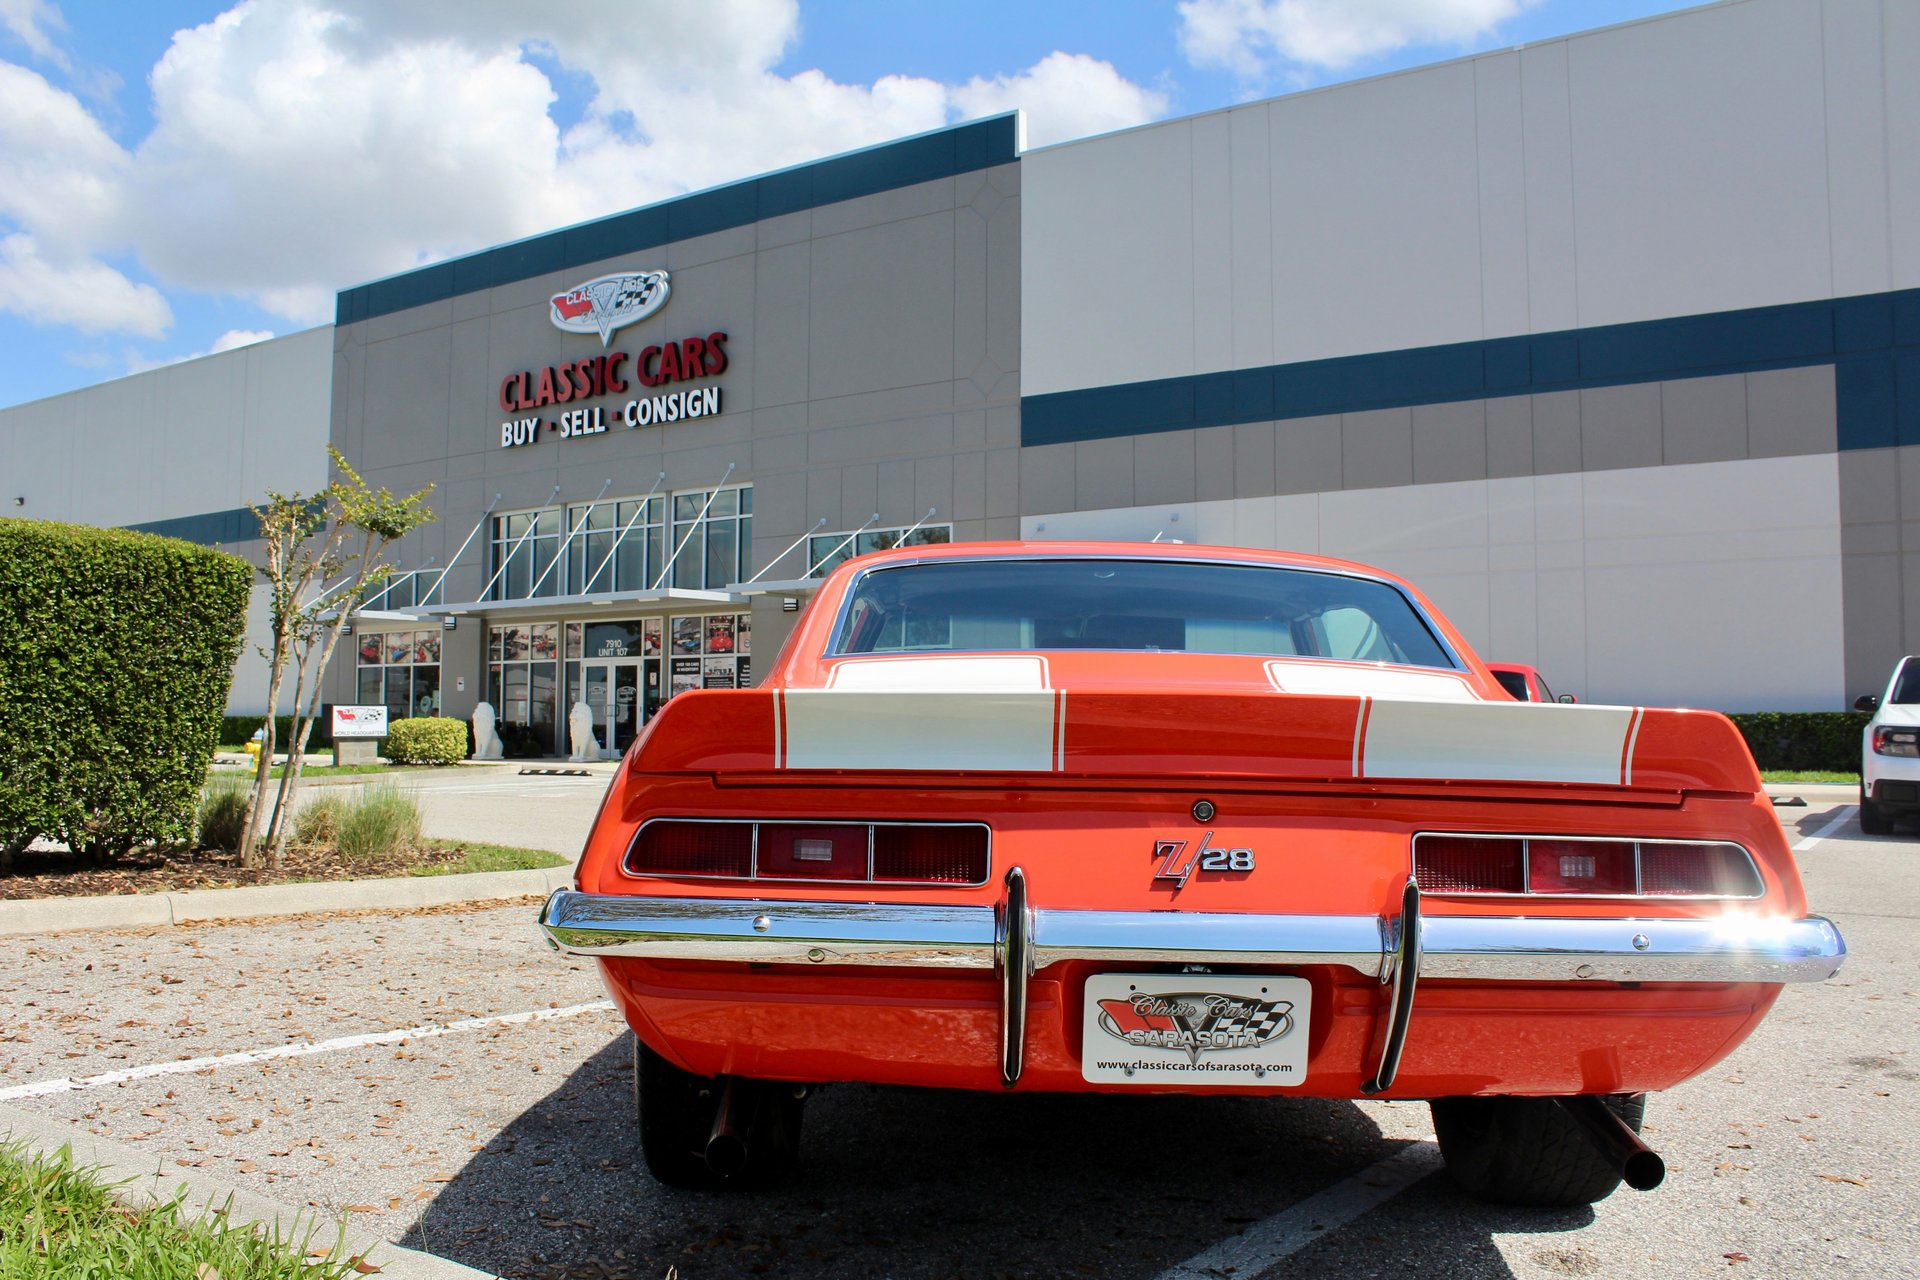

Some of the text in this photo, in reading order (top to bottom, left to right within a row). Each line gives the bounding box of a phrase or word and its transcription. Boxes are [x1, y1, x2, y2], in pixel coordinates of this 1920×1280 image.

[566, 286, 611, 305] CLASSIC
[500, 332, 728, 413] CLASSIC CARS
[502, 387, 720, 448] BUY SELL CONSIGN
[598, 647, 628, 656] UNIT 107
[605, 639, 622, 648] 7910
[1154, 831, 1256, 888] Z/28
[1128, 992, 1255, 1018] Classic Cars
[1128, 1030, 1260, 1049] SARASOTA
[1097, 1060, 1293, 1072] www.classiccarsofsarasota.com
